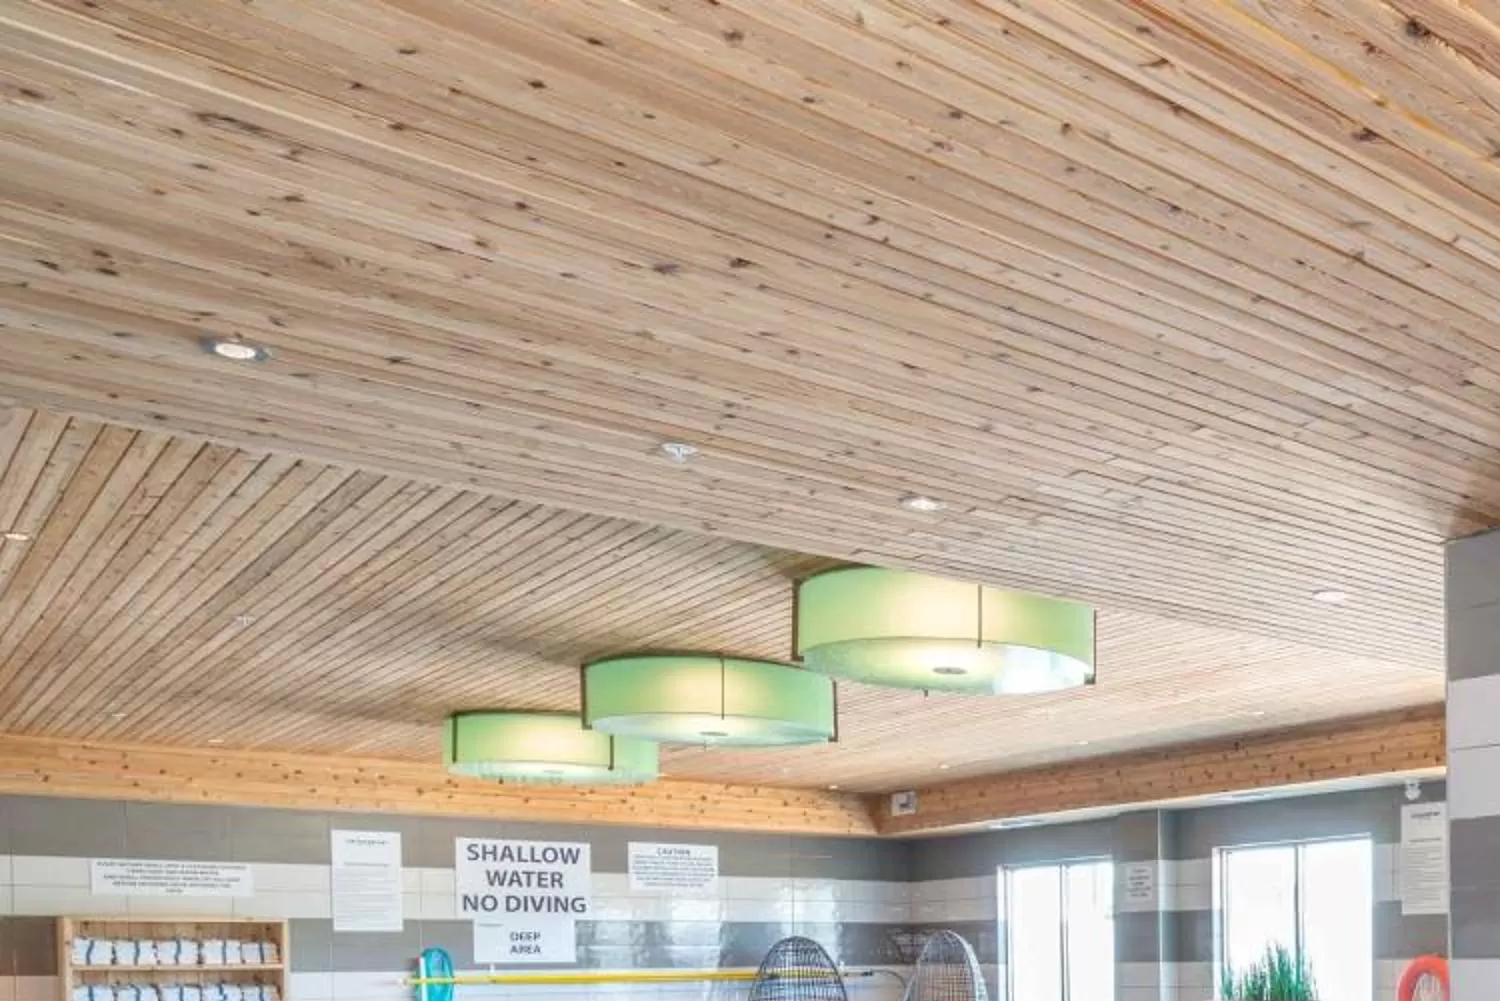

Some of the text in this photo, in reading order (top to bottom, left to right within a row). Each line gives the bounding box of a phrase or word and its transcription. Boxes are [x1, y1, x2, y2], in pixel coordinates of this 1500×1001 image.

[467, 843, 581, 865] SHALLOW
[486, 870, 564, 889] WATER
[462, 894, 587, 913] NO DIVING
[510, 931, 541, 941] DEEP
[510, 945, 542, 955] AREA
